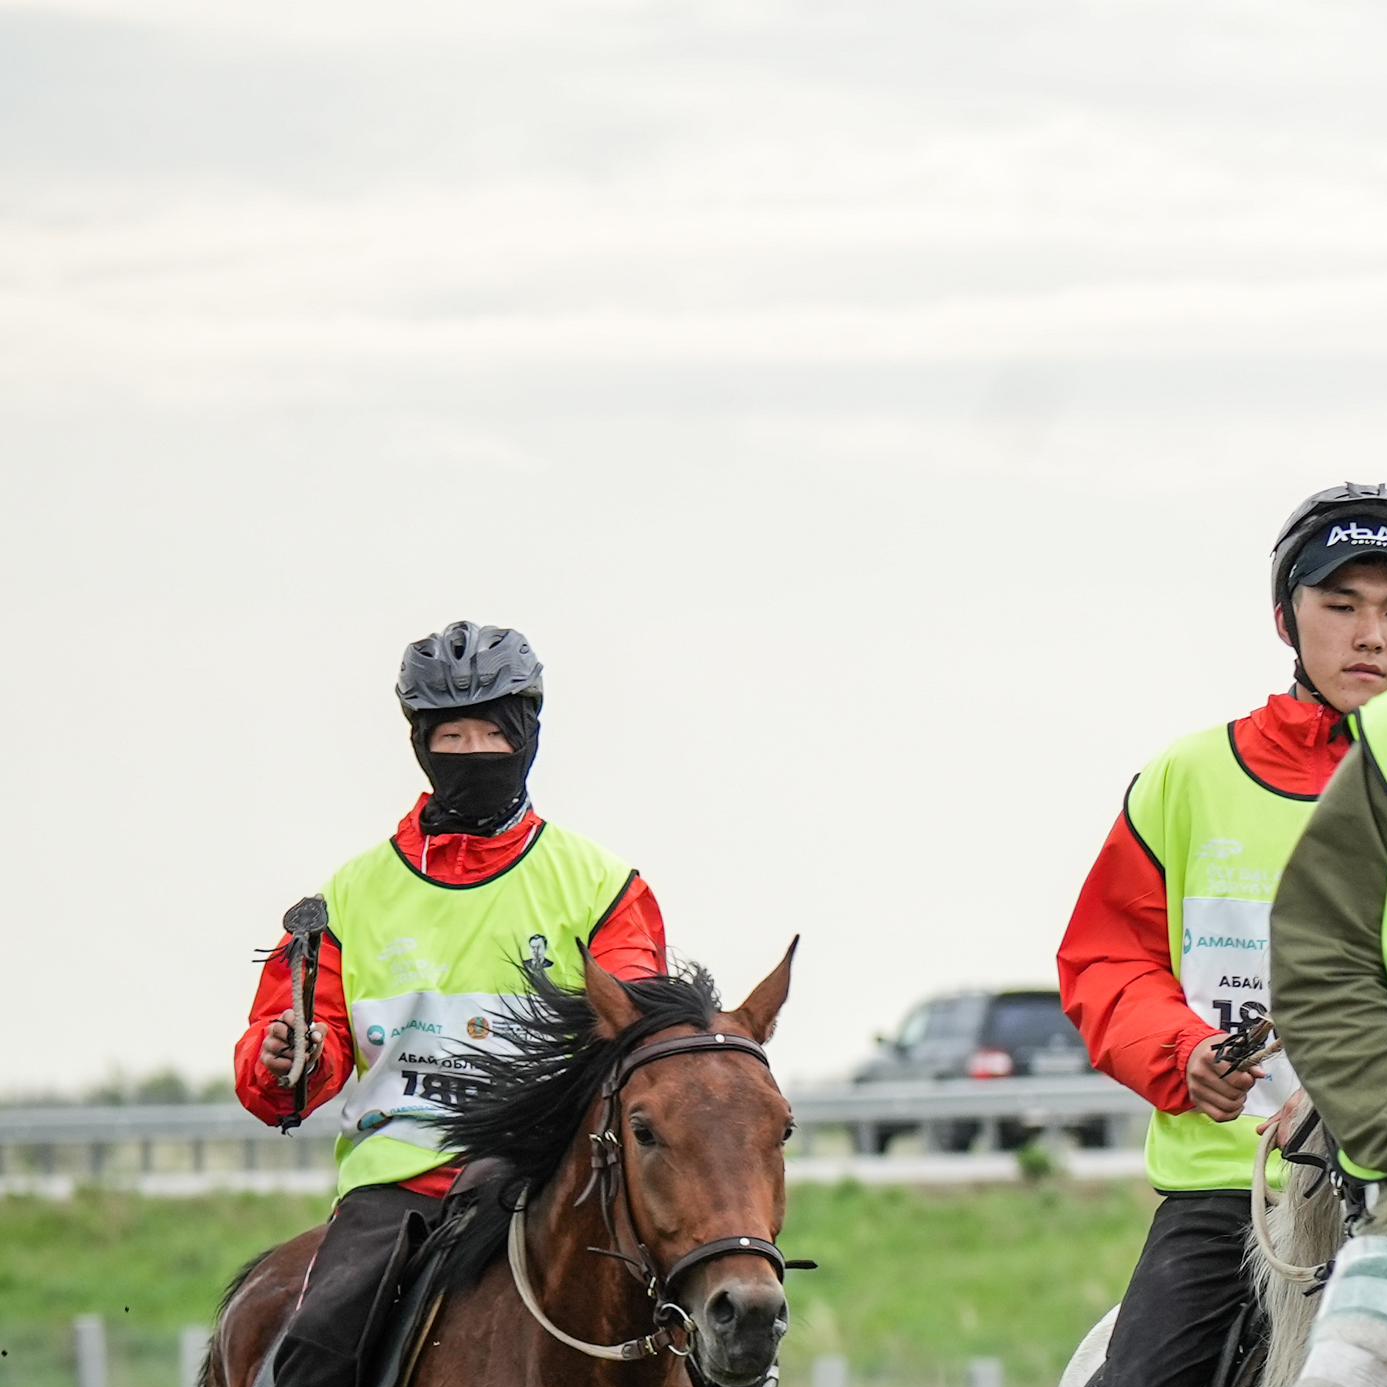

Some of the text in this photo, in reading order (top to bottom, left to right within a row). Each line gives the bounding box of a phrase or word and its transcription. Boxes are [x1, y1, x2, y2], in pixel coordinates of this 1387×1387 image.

[1197, 936, 1267, 951] AMANAT
[1219, 974, 1263, 990] АБАЙ
[398, 1052, 438, 1065] АБАЙ
